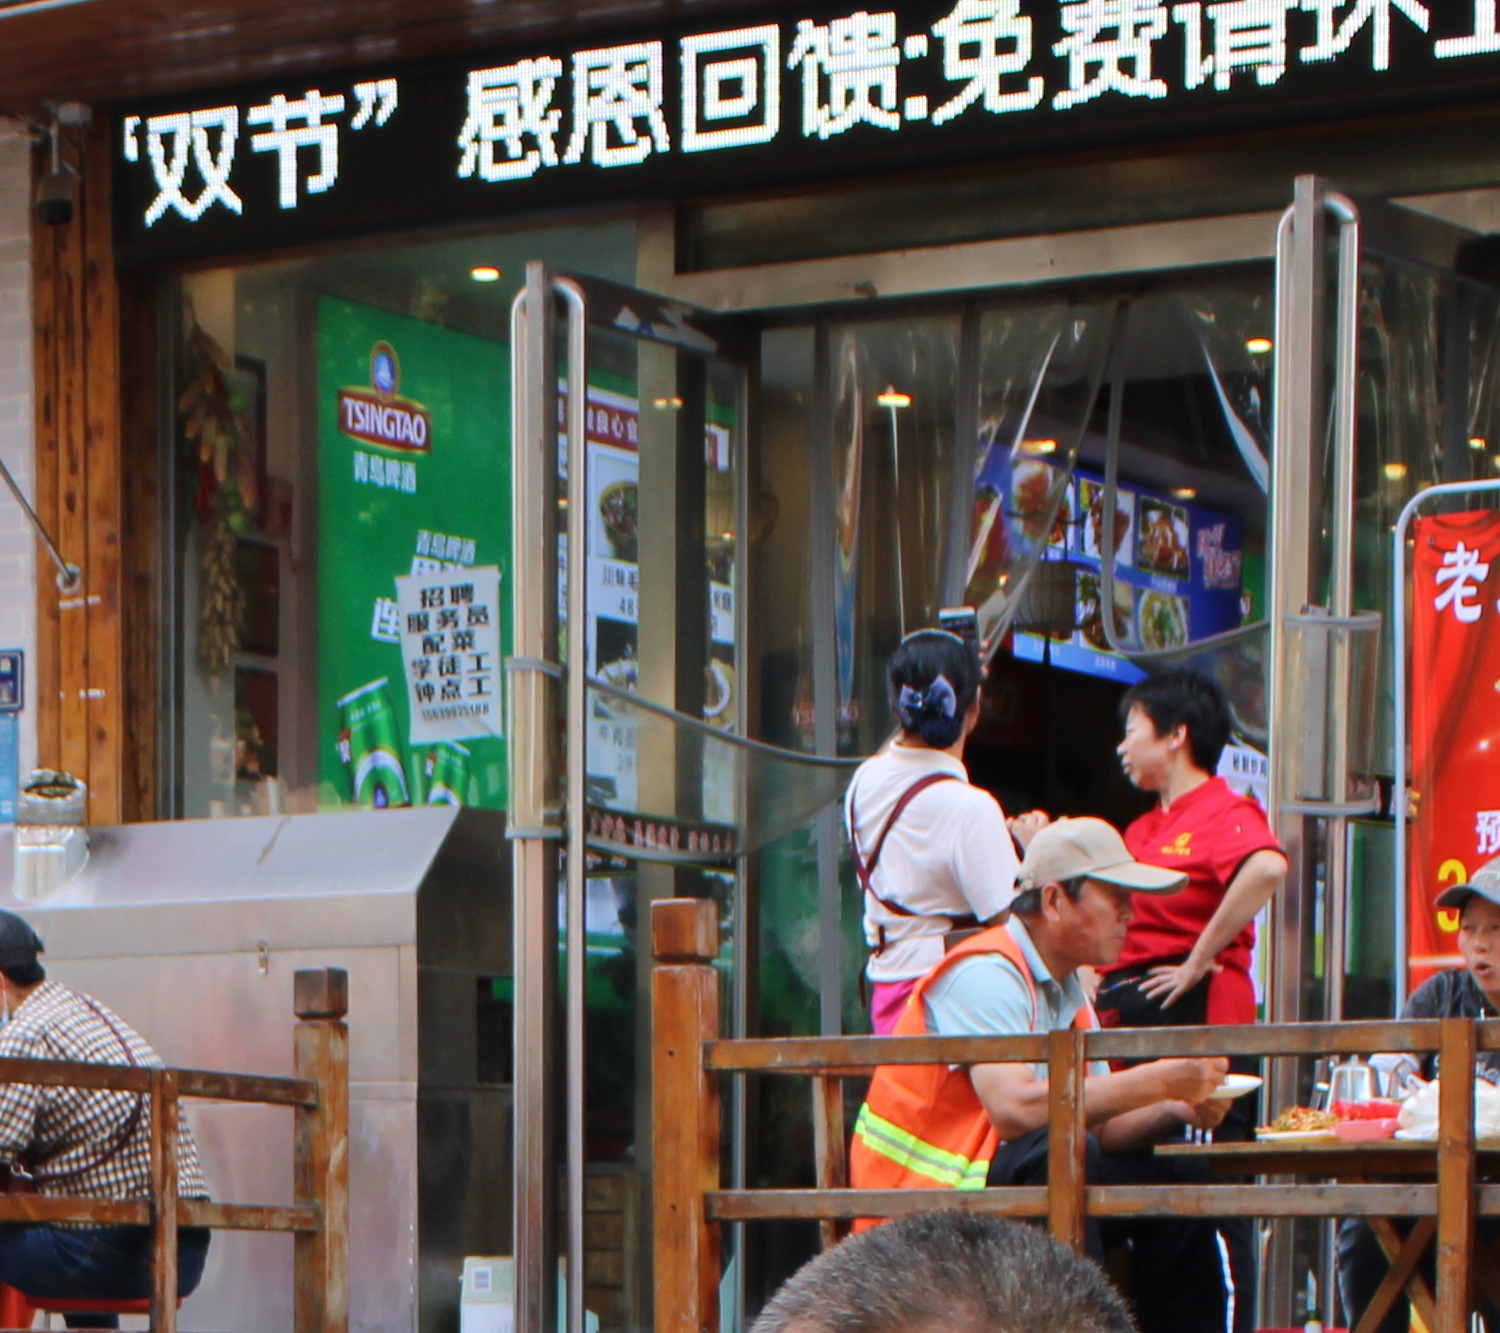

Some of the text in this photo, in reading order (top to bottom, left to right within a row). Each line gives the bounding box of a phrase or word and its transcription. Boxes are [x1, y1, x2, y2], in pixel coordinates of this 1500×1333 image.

[343, 396, 427, 446] TSINGTAO
[353, 450, 417, 495] 青岛啤酒
[420, 582, 475, 609] 招聘
[406, 605, 490, 634] 服务员
[411, 651, 492, 679] 学徒工
[414, 675, 493, 704] 钟点工
